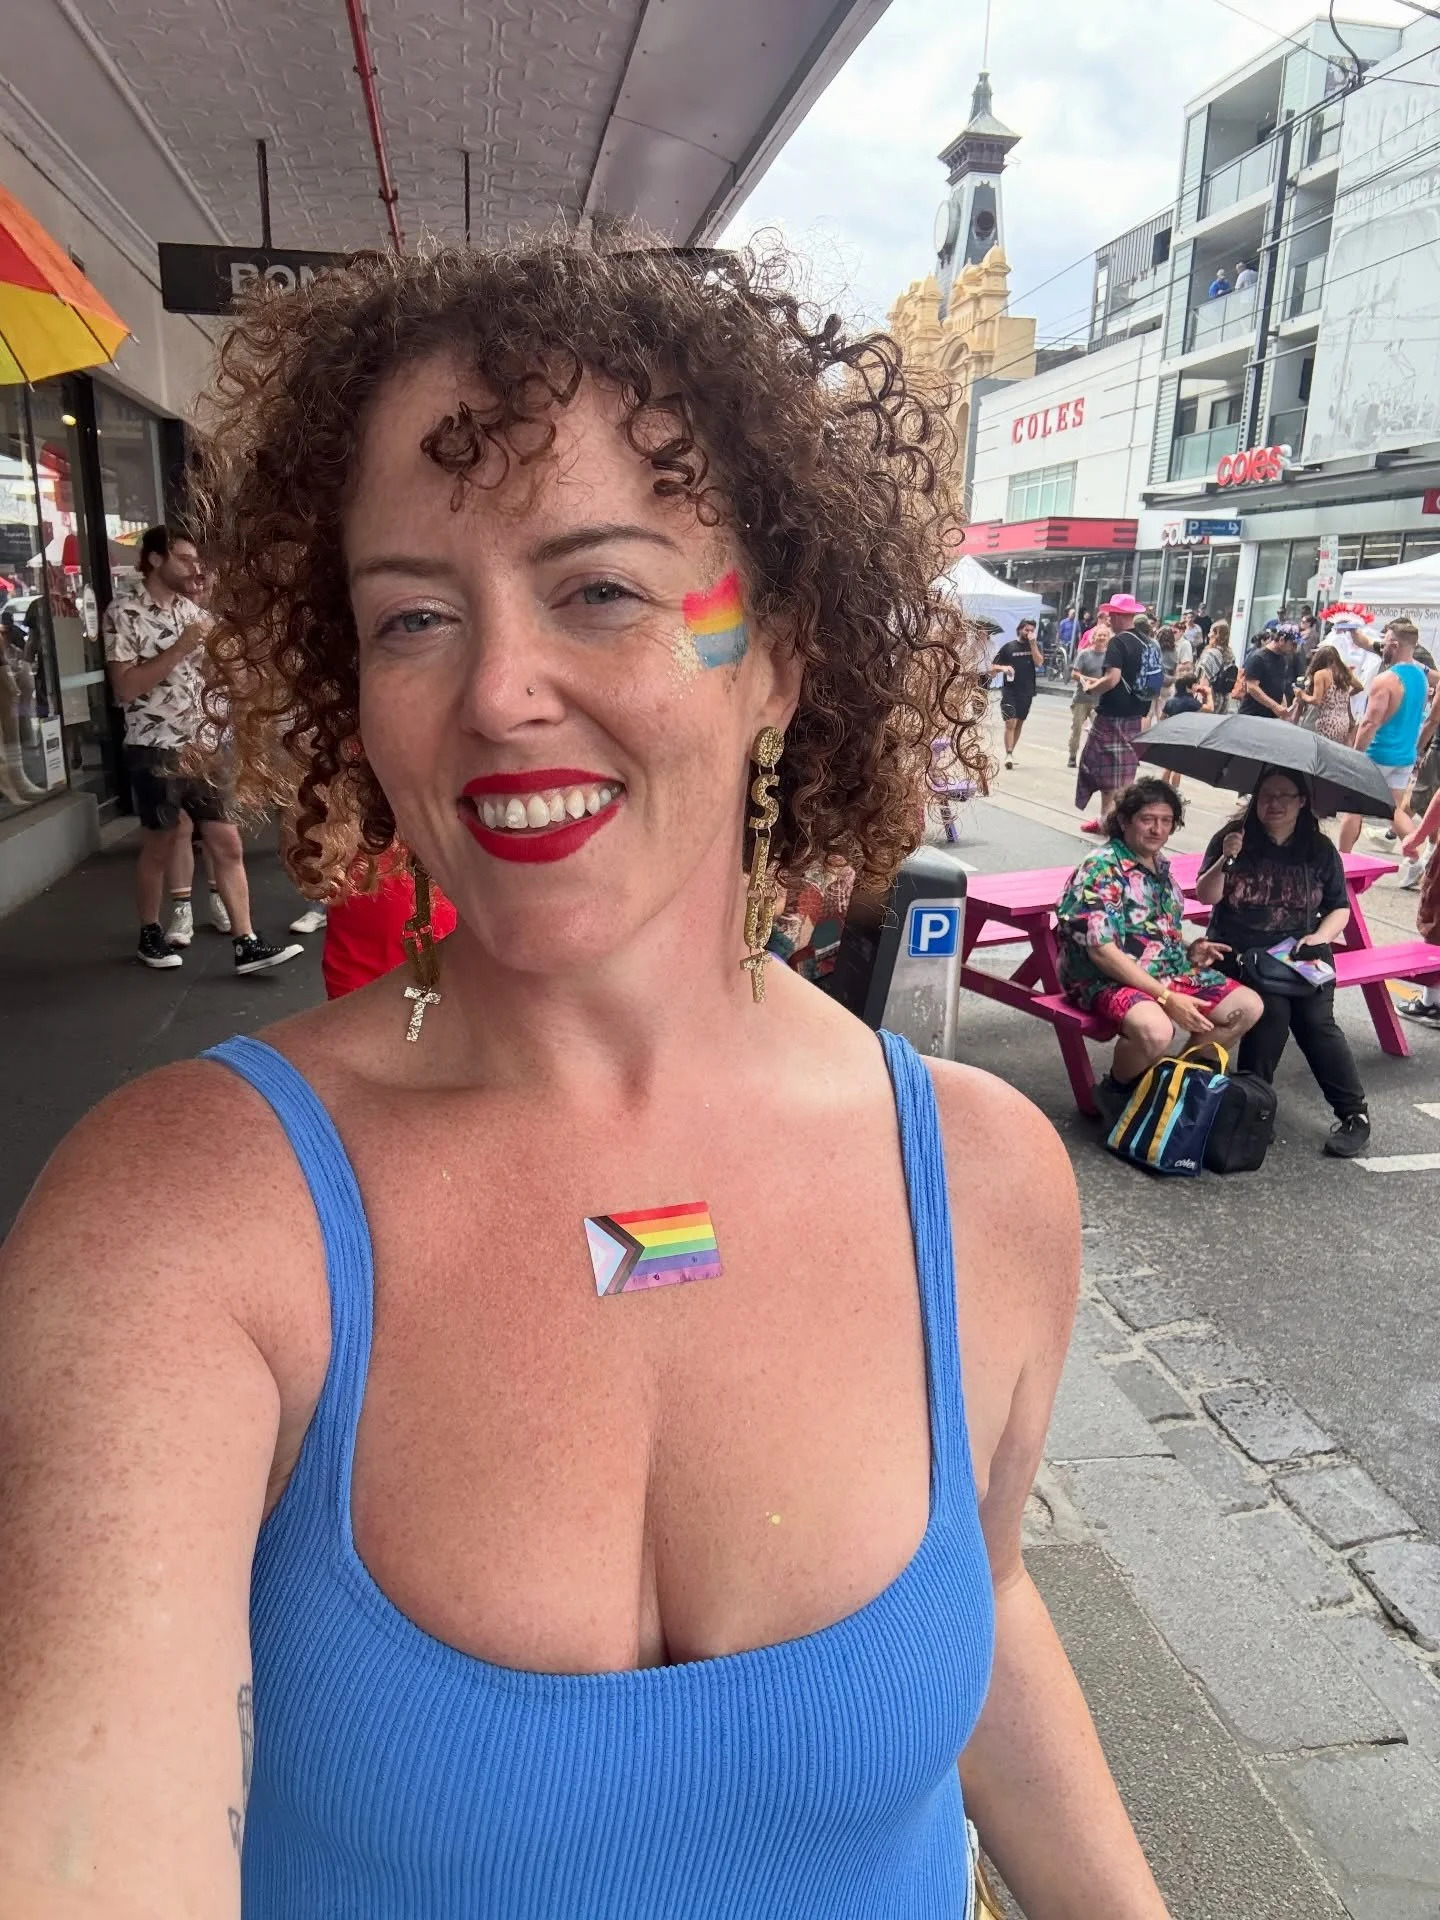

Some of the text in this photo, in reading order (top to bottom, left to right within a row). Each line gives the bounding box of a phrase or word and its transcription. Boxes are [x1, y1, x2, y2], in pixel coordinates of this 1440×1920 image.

[1012, 397, 1085, 444] COLES
[1217, 445, 1283, 487] coles
[1188, 520, 1200, 535] P
[1400, 607, 1423, 620] Family
[920, 913, 950, 952] P
